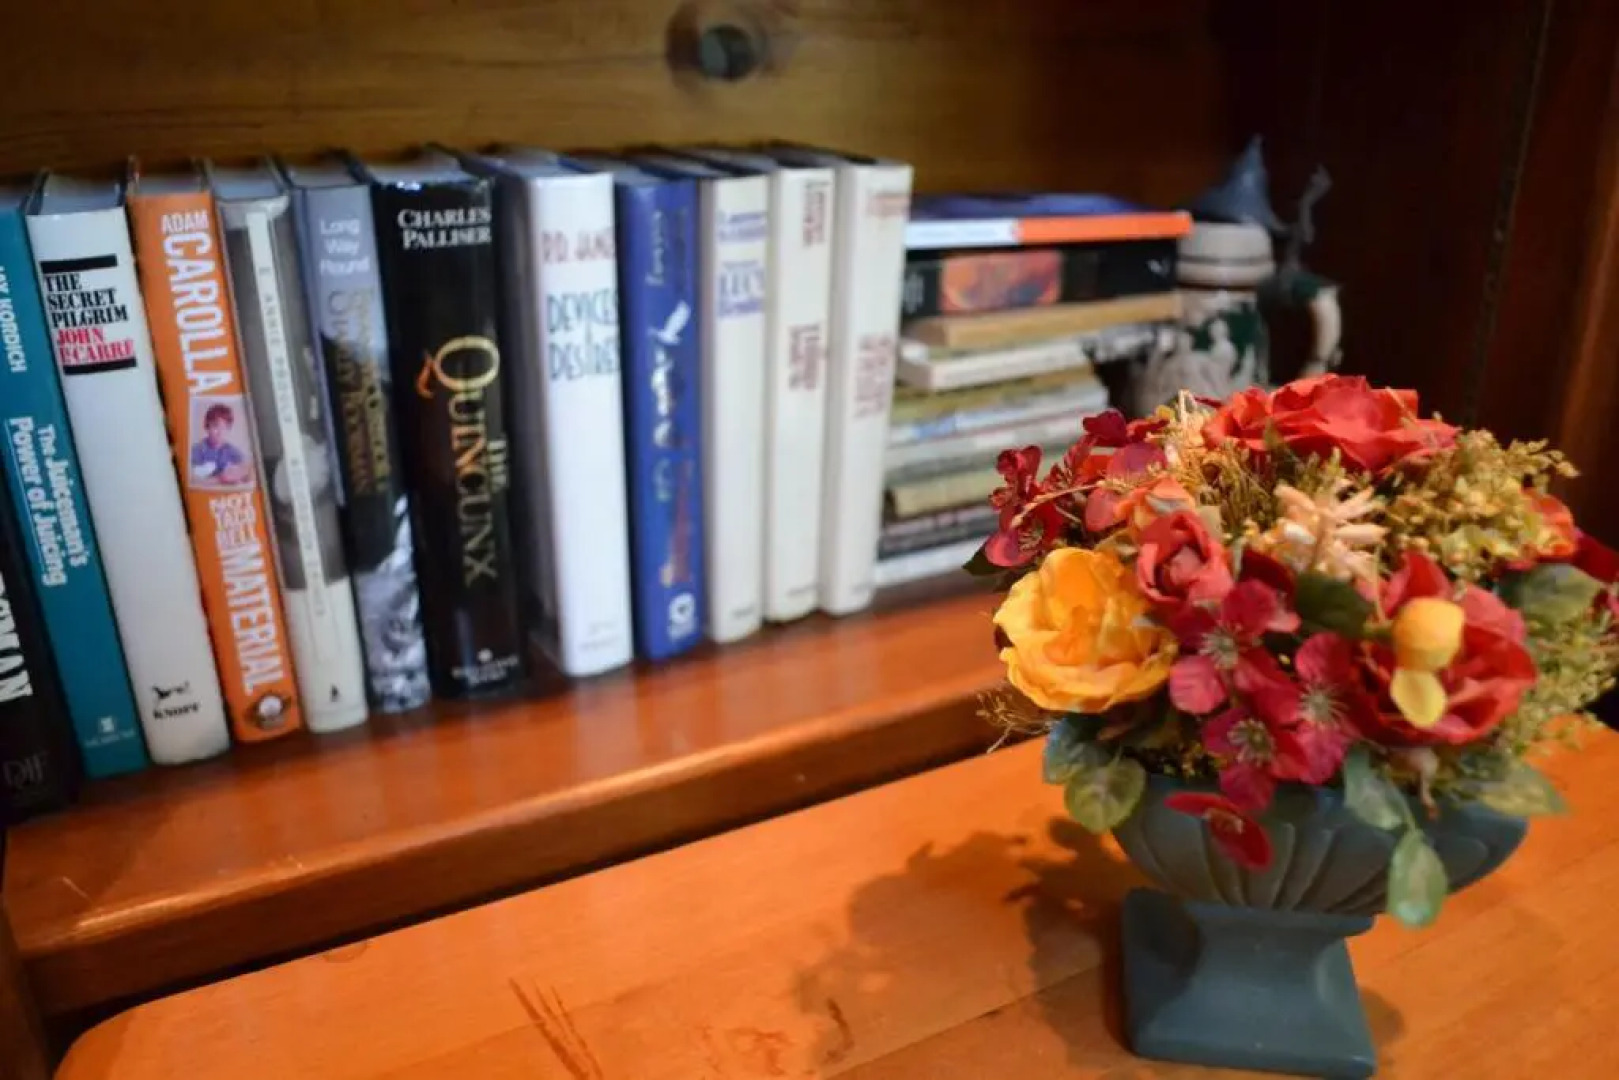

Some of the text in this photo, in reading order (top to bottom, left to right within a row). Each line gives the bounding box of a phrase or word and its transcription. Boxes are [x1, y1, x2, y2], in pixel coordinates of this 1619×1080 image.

[161, 210, 210, 234] ADAM
[320, 218, 360, 236] Long
[397, 207, 493, 229] CHARLES
[323, 238, 360, 256] Way
[402, 226, 493, 250] PALLISER
[320, 256, 371, 276] Round
[44, 273, 83, 292] THE
[46, 287, 117, 311] SECRET
[51, 304, 129, 328] PILGRIM
[163, 232, 234, 395] CAROLLA
[57, 328, 104, 345] JOHN
[417, 335, 500, 588] QUINCUNX
[9, 417, 68, 586] Power of Juicing
[38, 424, 90, 568] The Juiceman's
[219, 543, 285, 695] MATERIAL
